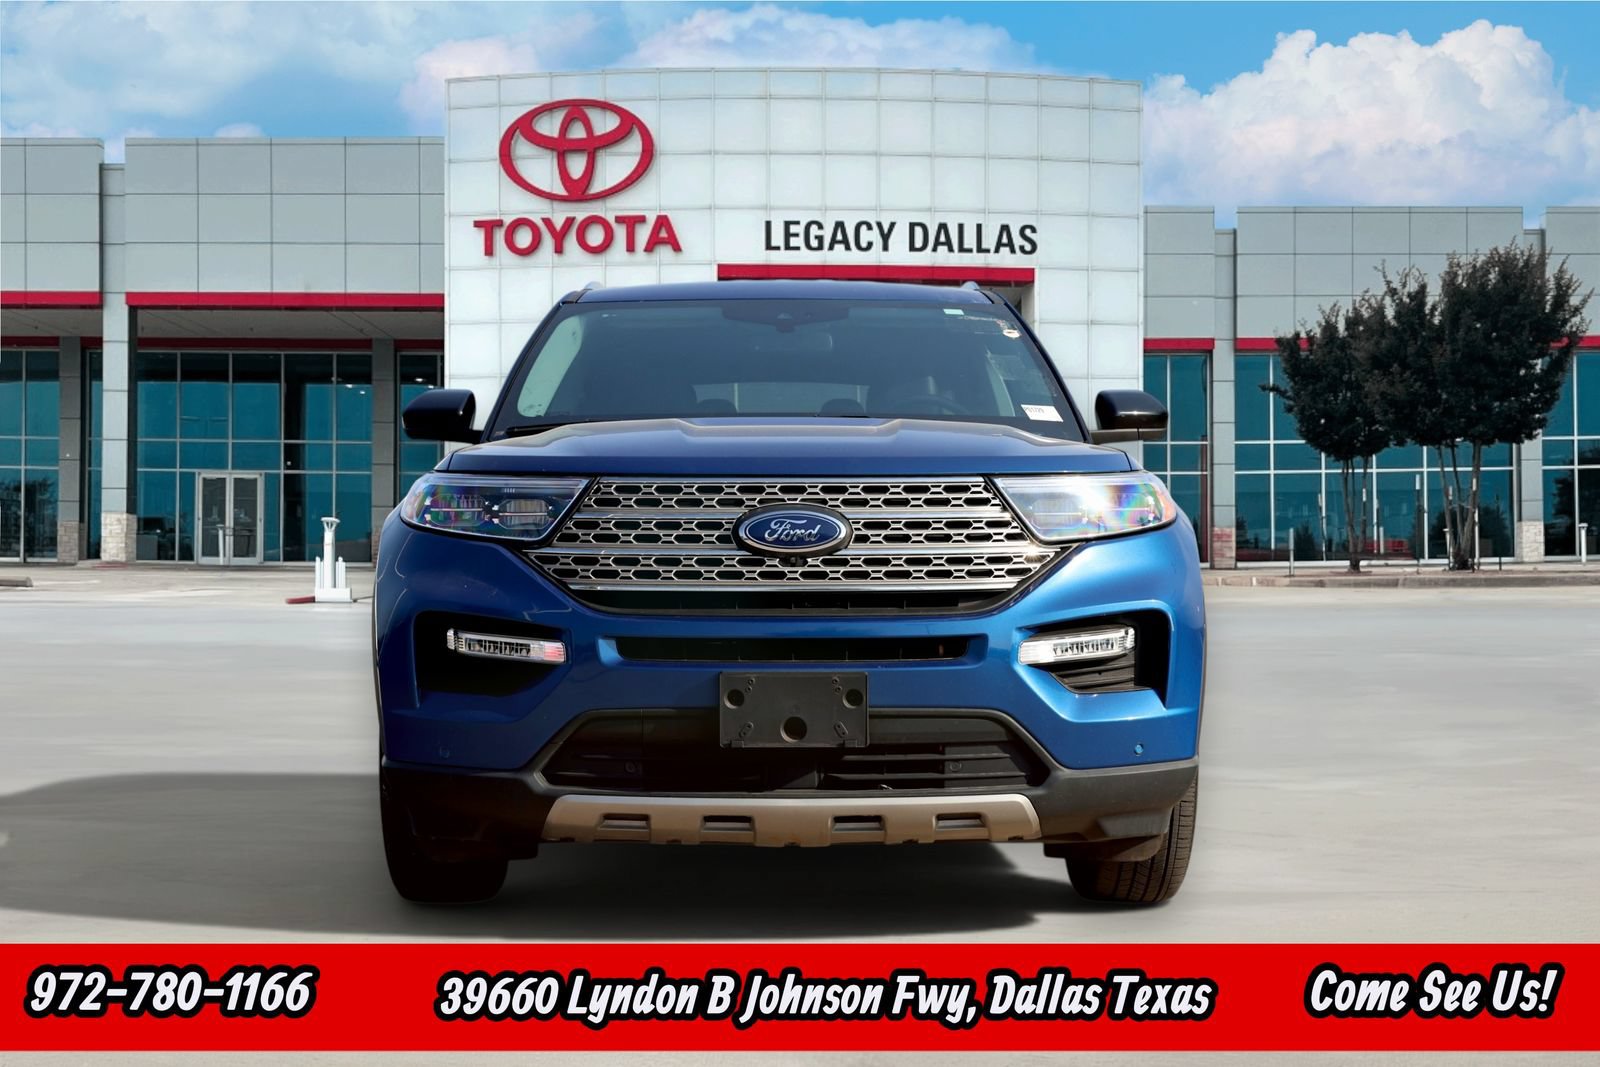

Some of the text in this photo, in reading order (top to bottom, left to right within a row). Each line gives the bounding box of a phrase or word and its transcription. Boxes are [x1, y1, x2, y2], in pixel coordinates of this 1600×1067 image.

[474, 214, 682, 257] TOYOTA
[764, 220, 1038, 256] LEGACY DALLAS
[764, 518, 822, 542] Ford
